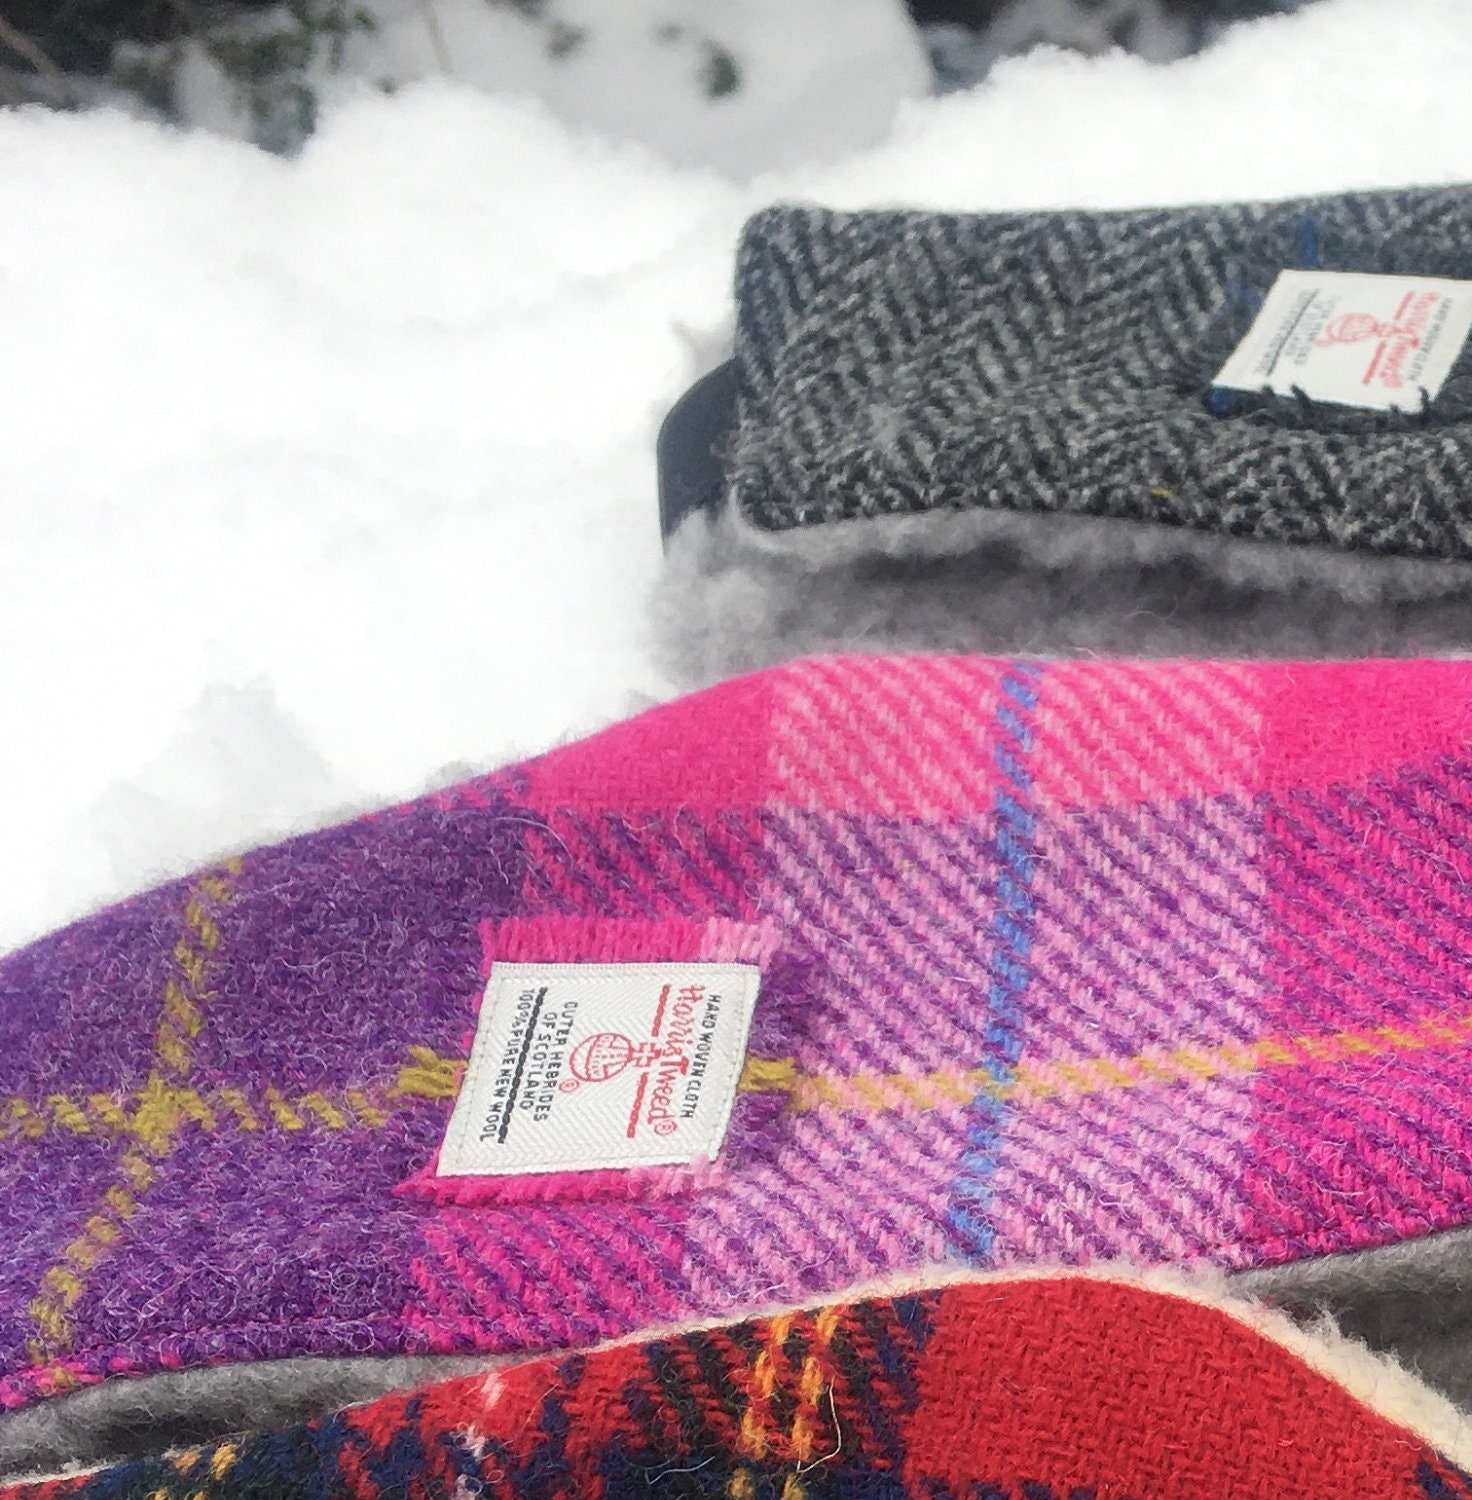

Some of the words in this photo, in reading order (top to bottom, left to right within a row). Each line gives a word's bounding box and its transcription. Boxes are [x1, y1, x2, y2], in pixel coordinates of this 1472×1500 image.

[542, 1012, 557, 1030] OF
[555, 1001, 578, 1046] OUTER
[662, 983, 706, 1057] Harris
[702, 994, 722, 1029] HAND
[520, 1033, 552, 1110] SCOTLAND
[691, 1032, 714, 1077] WOVEN
[493, 1068, 512, 1098] NEW
[534, 1051, 564, 1122] HEBRIDES
[680, 1080, 701, 1119] CLOTH
[480, 1101, 504, 1142] WOOL
